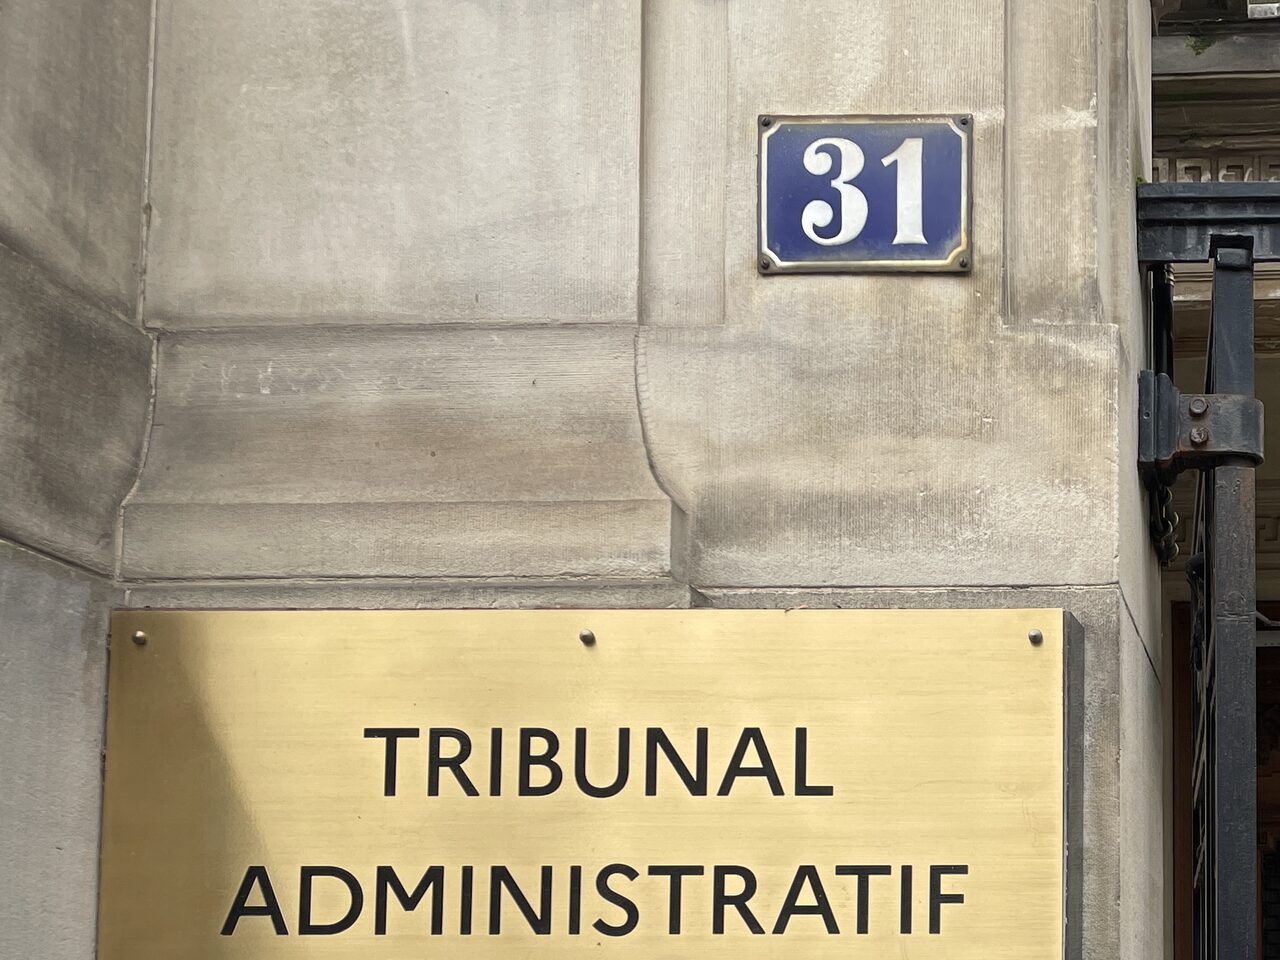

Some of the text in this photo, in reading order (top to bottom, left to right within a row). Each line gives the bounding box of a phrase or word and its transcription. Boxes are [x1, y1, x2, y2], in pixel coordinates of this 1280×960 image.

[801, 137, 928, 246] 31
[364, 727, 834, 798] TRIBUNAL
[220, 863, 969, 937] ADMINISTRATIF
